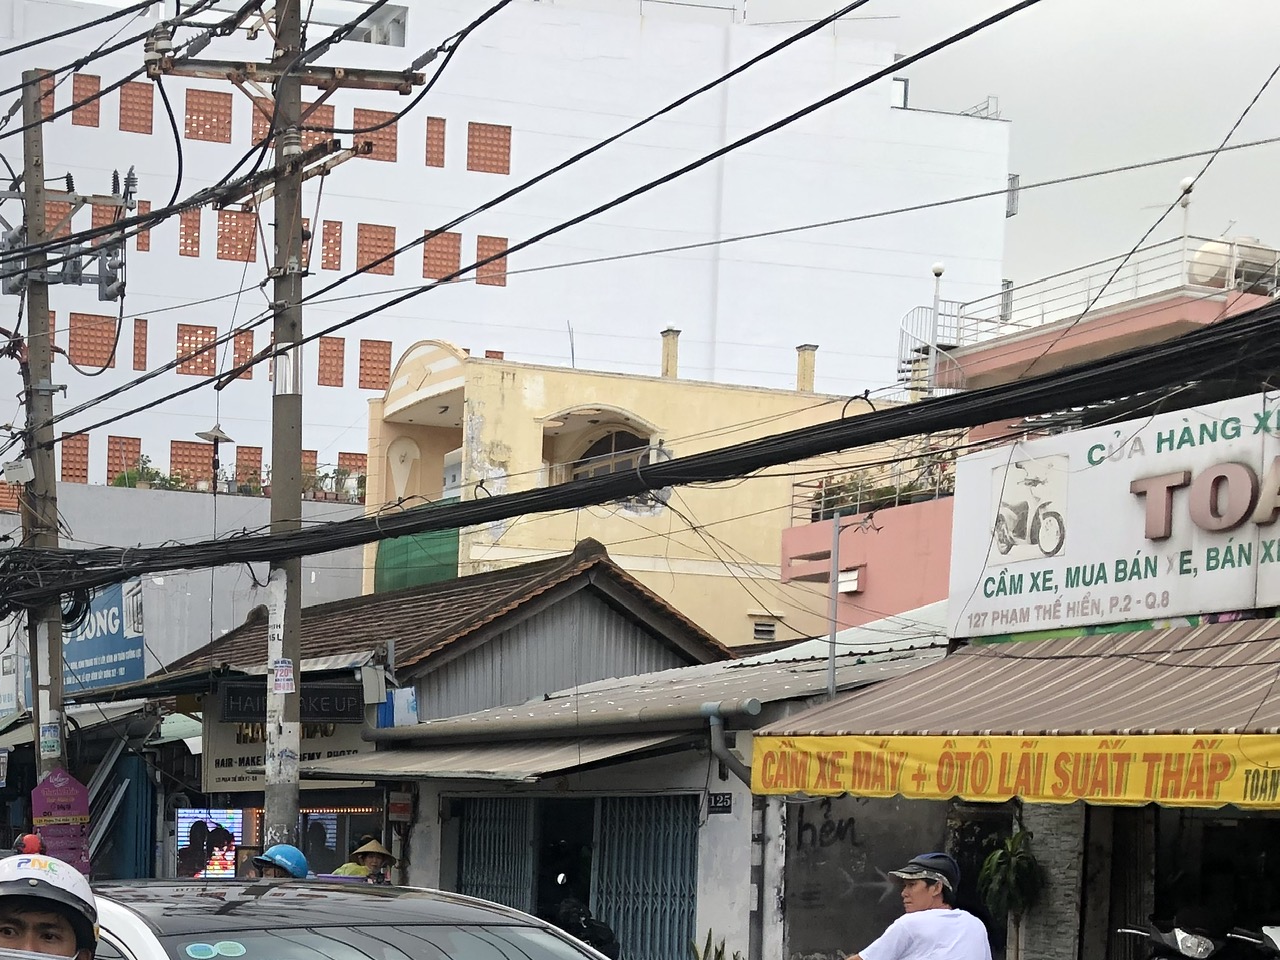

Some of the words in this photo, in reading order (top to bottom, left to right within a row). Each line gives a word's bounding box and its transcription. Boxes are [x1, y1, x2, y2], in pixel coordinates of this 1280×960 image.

[1156, 418, 1241, 453] HÀNG
[1253, 410, 1280, 435] X
[983, 568, 1023, 598] CẦM
[1029, 570, 1059, 594] XE,
[1065, 562, 1108, 588] MUA
[1114, 550, 1158, 583] BÁN
[1206, 537, 1252, 571] BÁN
[1260, 539, 1280, 564] X
[968, 612, 989, 629] 127
[991, 607, 1030, 627] PHẠM
[1034, 594, 1063, 620] THẾ
[1109, 594, 1132, 614] P.2
[1145, 590, 1170, 610] Q.8
[335, 696, 357, 712] UP
[761, 739, 811, 789] CẦM
[814, 750, 847, 790] XE
[851, 739, 908, 791] MÁY
[937, 739, 993, 795] ÔTÔ
[998, 740, 1048, 796] LÃI
[1051, 739, 1137, 798] SUẤT
[1142, 739, 1237, 800] THẤP
[710, 794, 731, 807] 125
